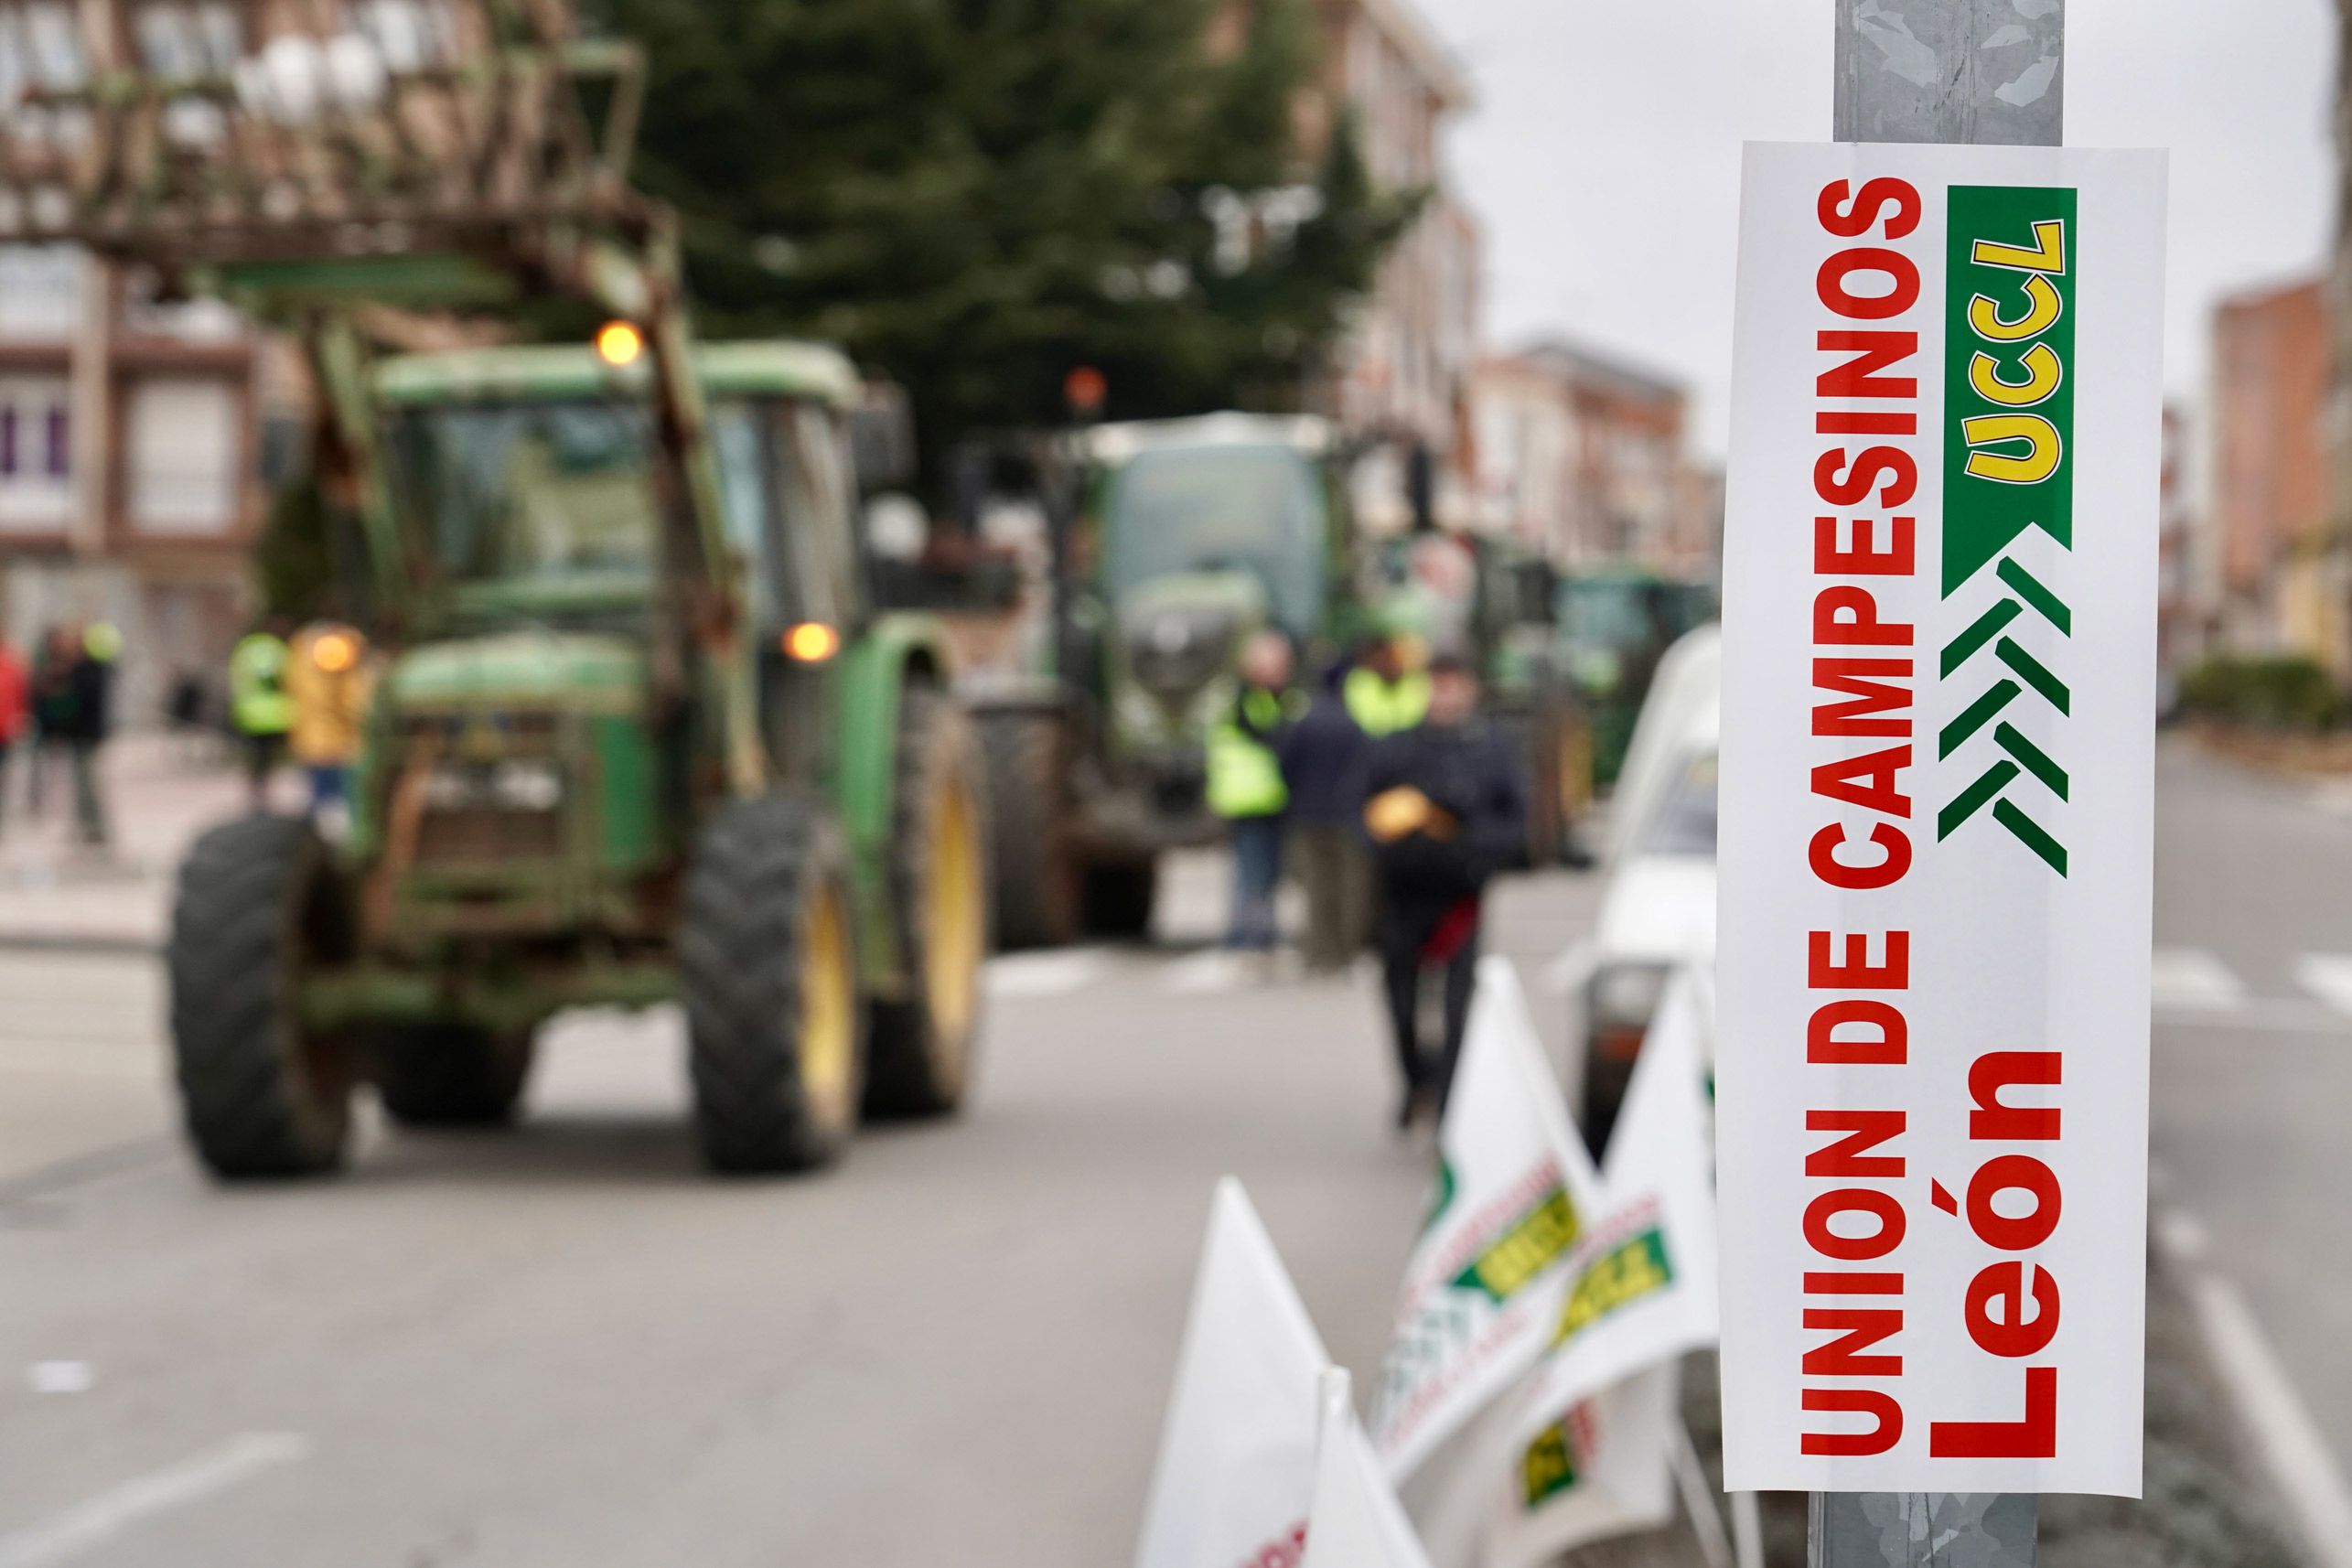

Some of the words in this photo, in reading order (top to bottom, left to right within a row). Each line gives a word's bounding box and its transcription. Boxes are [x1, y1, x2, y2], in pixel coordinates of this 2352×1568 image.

[1960, 218, 2066, 486] UCCL
[1808, 177, 1922, 890] CAMPESINOS
[1807, 930, 1910, 1066] DE
[1800, 1111, 1907, 1456] UNION
[1929, 1051, 2063, 1459] León
